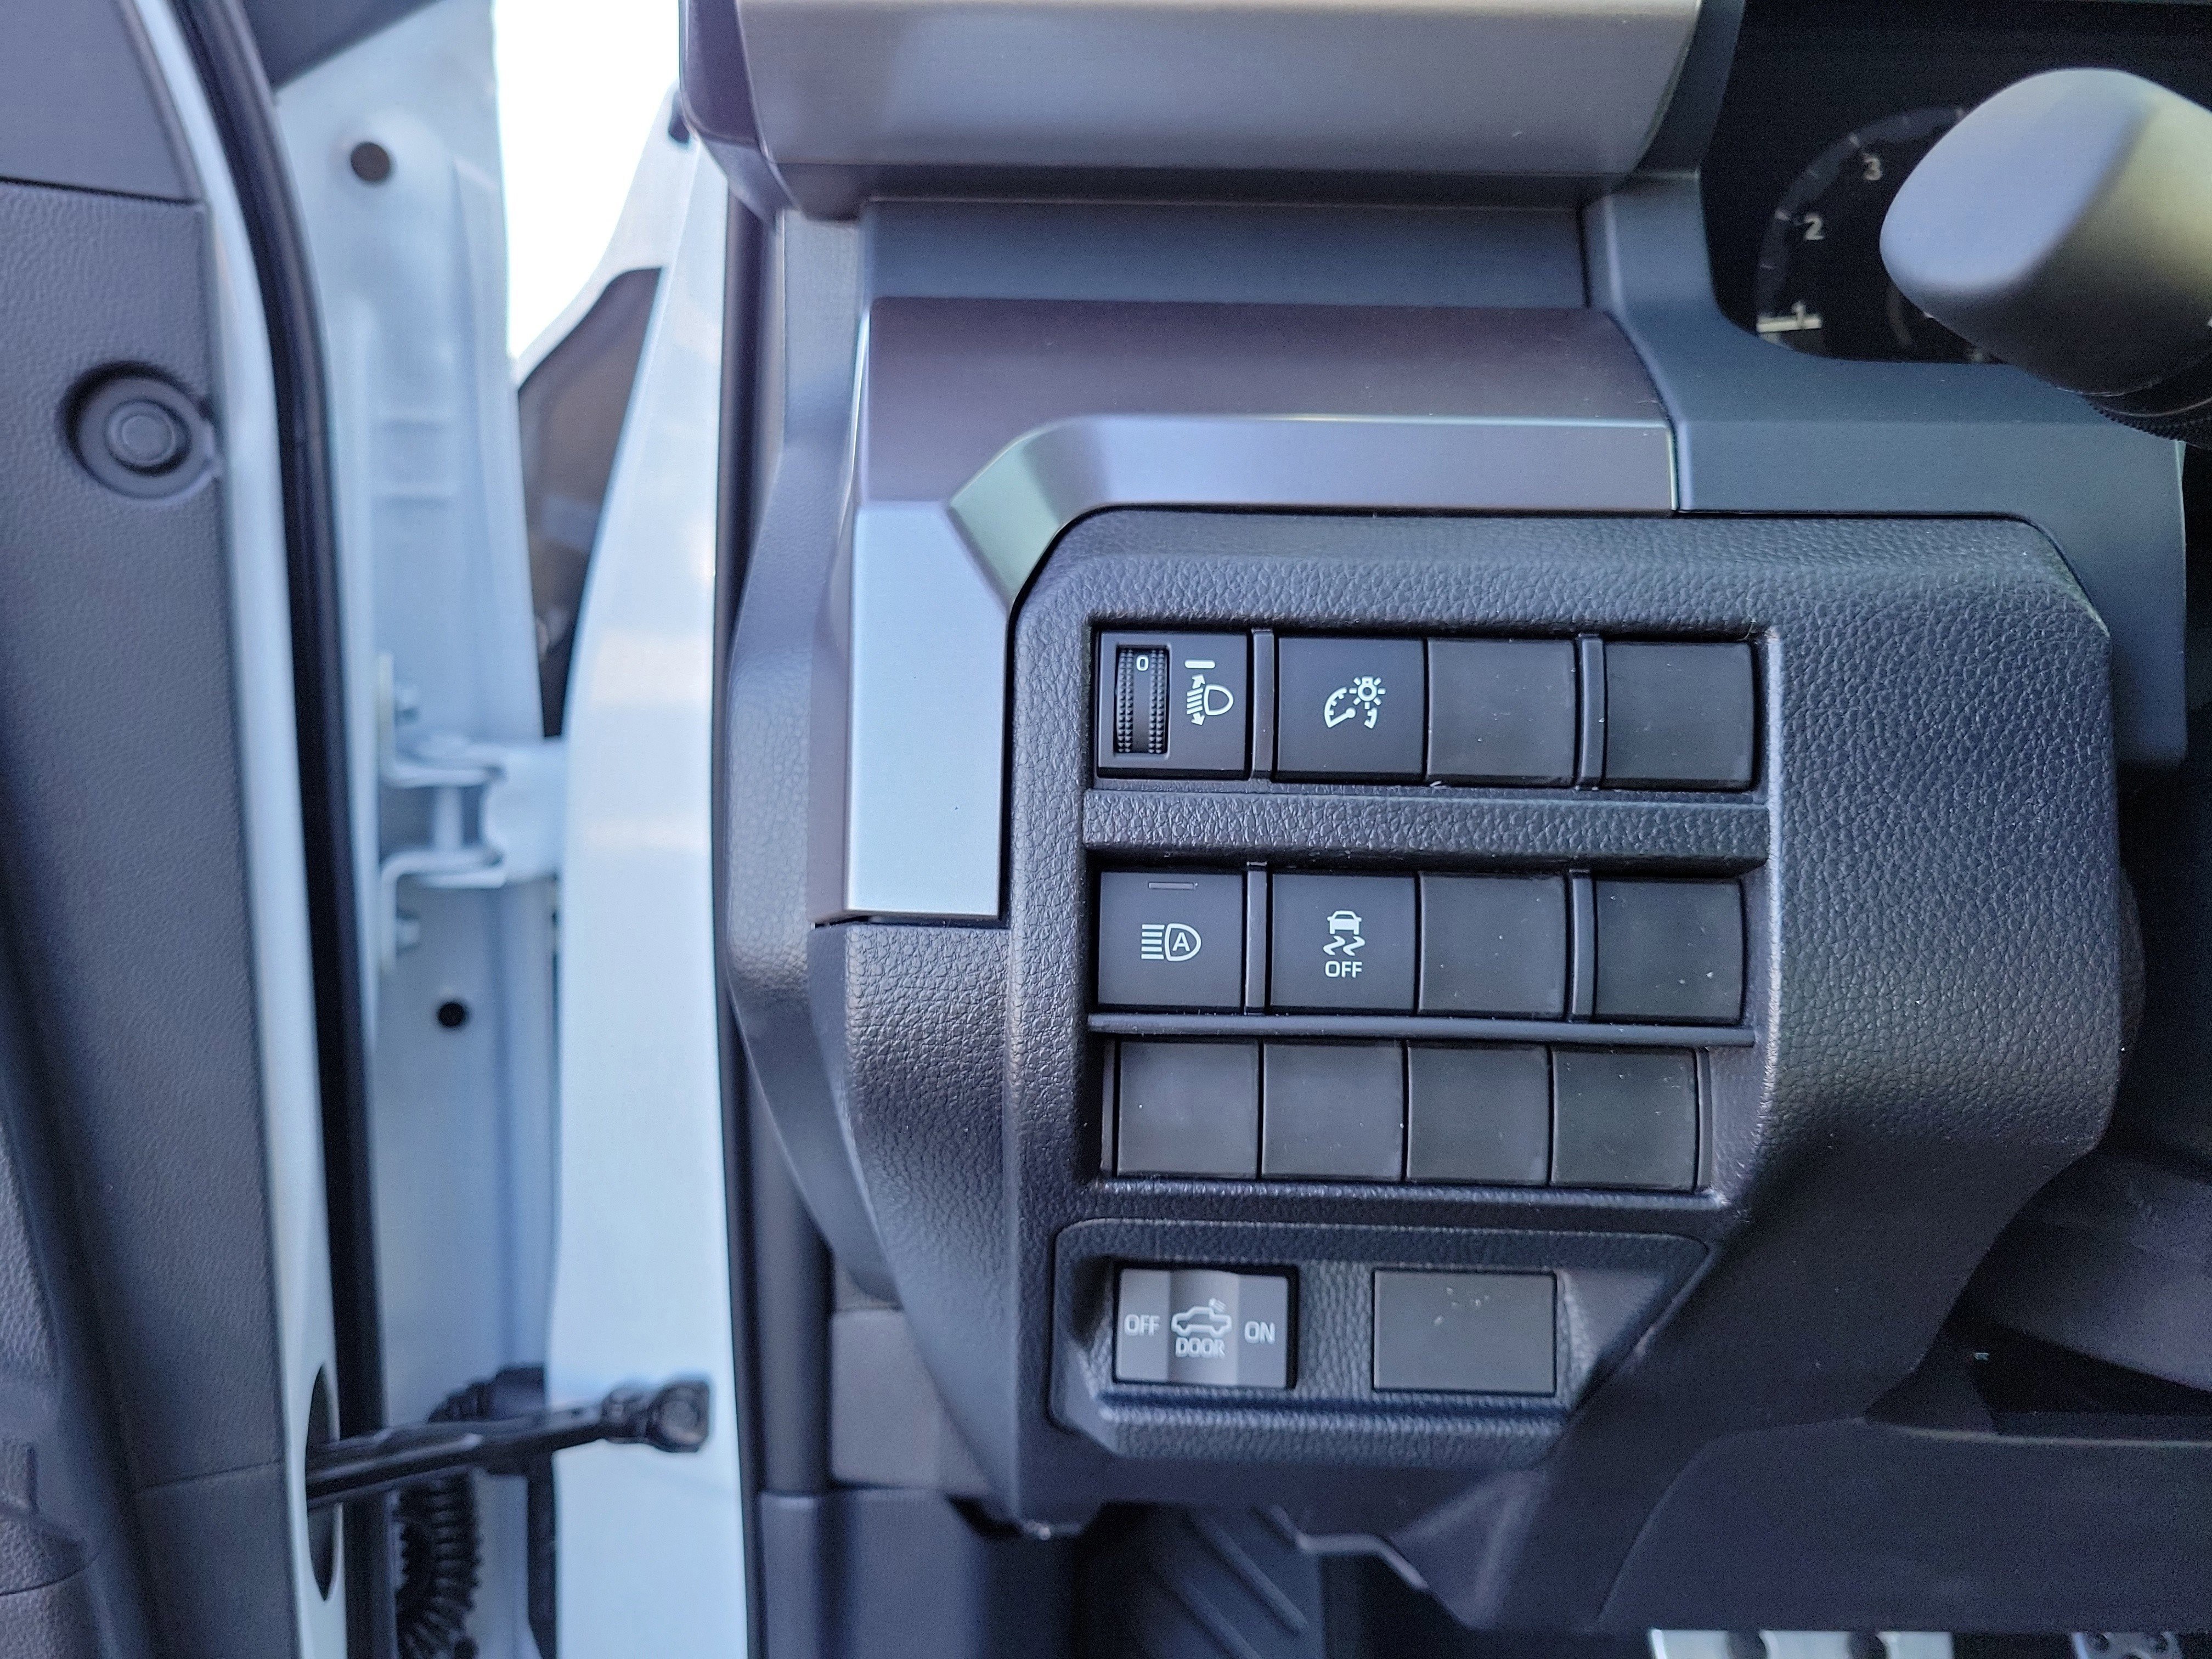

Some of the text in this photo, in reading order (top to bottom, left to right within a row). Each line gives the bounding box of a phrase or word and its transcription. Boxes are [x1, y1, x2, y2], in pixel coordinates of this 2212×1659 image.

[1863, 155, 1882, 181] 3
[1803, 212, 1824, 240] 2
[1172, 932, 1191, 952] A
[1325, 961, 1363, 978] OFF
[1125, 1313, 1160, 1337] OFF
[1244, 1321, 1276, 1345] ON
[1175, 1336, 1226, 1358] DOOR
